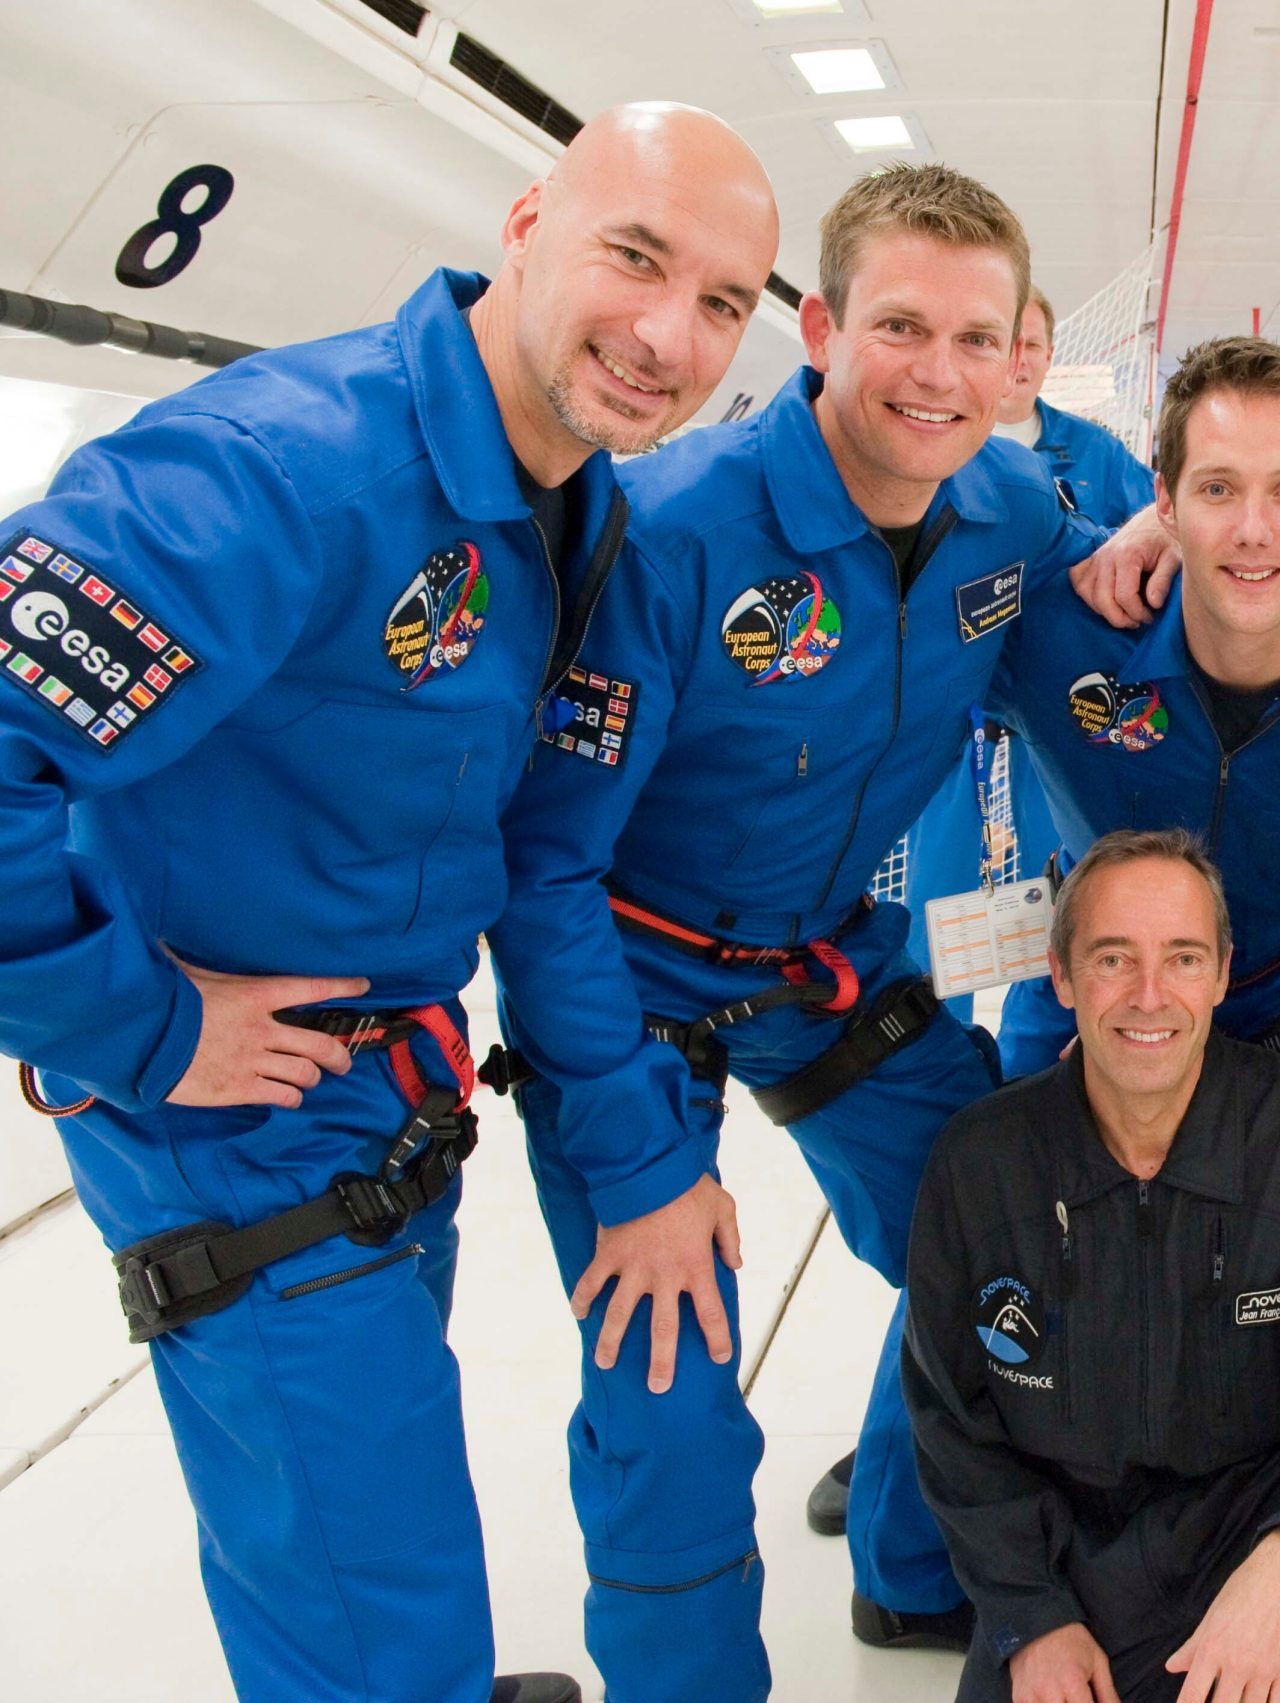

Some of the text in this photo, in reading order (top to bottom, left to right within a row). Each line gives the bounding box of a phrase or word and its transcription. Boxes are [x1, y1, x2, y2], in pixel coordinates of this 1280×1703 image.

[115, 163, 235, 289] 8
[385, 619, 425, 641] European
[725, 630, 770, 646] European
[388, 632, 430, 656] Astronaut
[731, 642, 778, 657] Astronaut
[400, 652, 424, 670] Corps
[745, 656, 771, 672] Corps
[1070, 694, 1106, 714] European
[1072, 706, 1110, 726] Astronaut
[1081, 718, 1104, 733] Corps
[980, 1277, 1031, 1306] NOVESPACE
[1239, 1310, 1259, 1321] Jean
